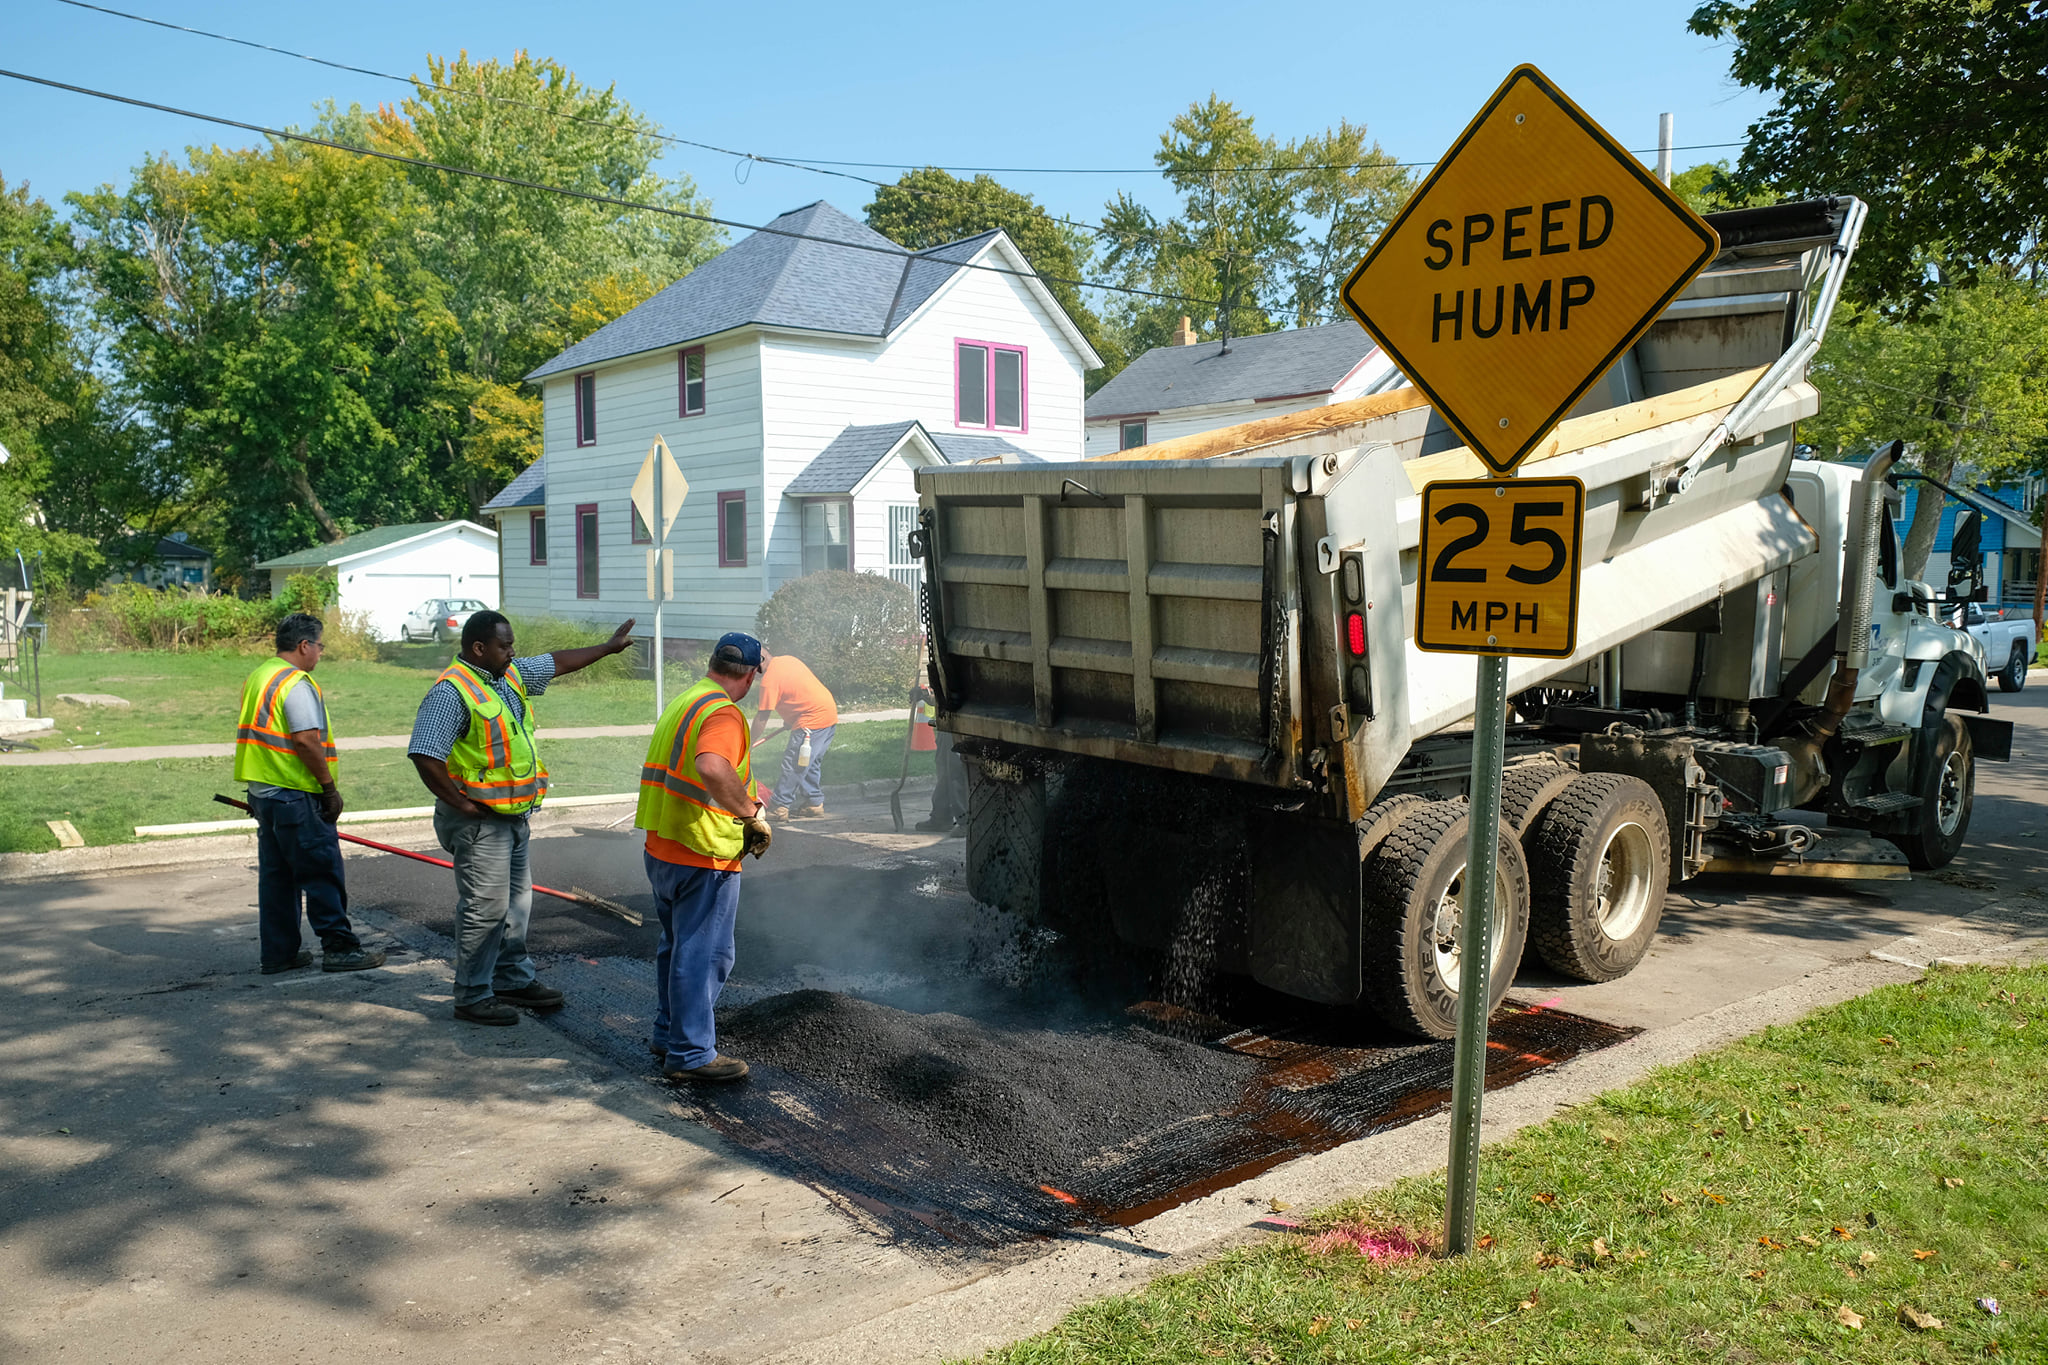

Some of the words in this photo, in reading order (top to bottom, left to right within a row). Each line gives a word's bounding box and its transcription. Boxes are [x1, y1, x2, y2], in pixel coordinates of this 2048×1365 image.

[1423, 194, 1614, 271] SPEED
[1431, 275, 1596, 344] HUMP
[1430, 501, 1567, 585] 25
[1451, 600, 1539, 634] MPH
[1515, 876, 1527, 933] RSD
